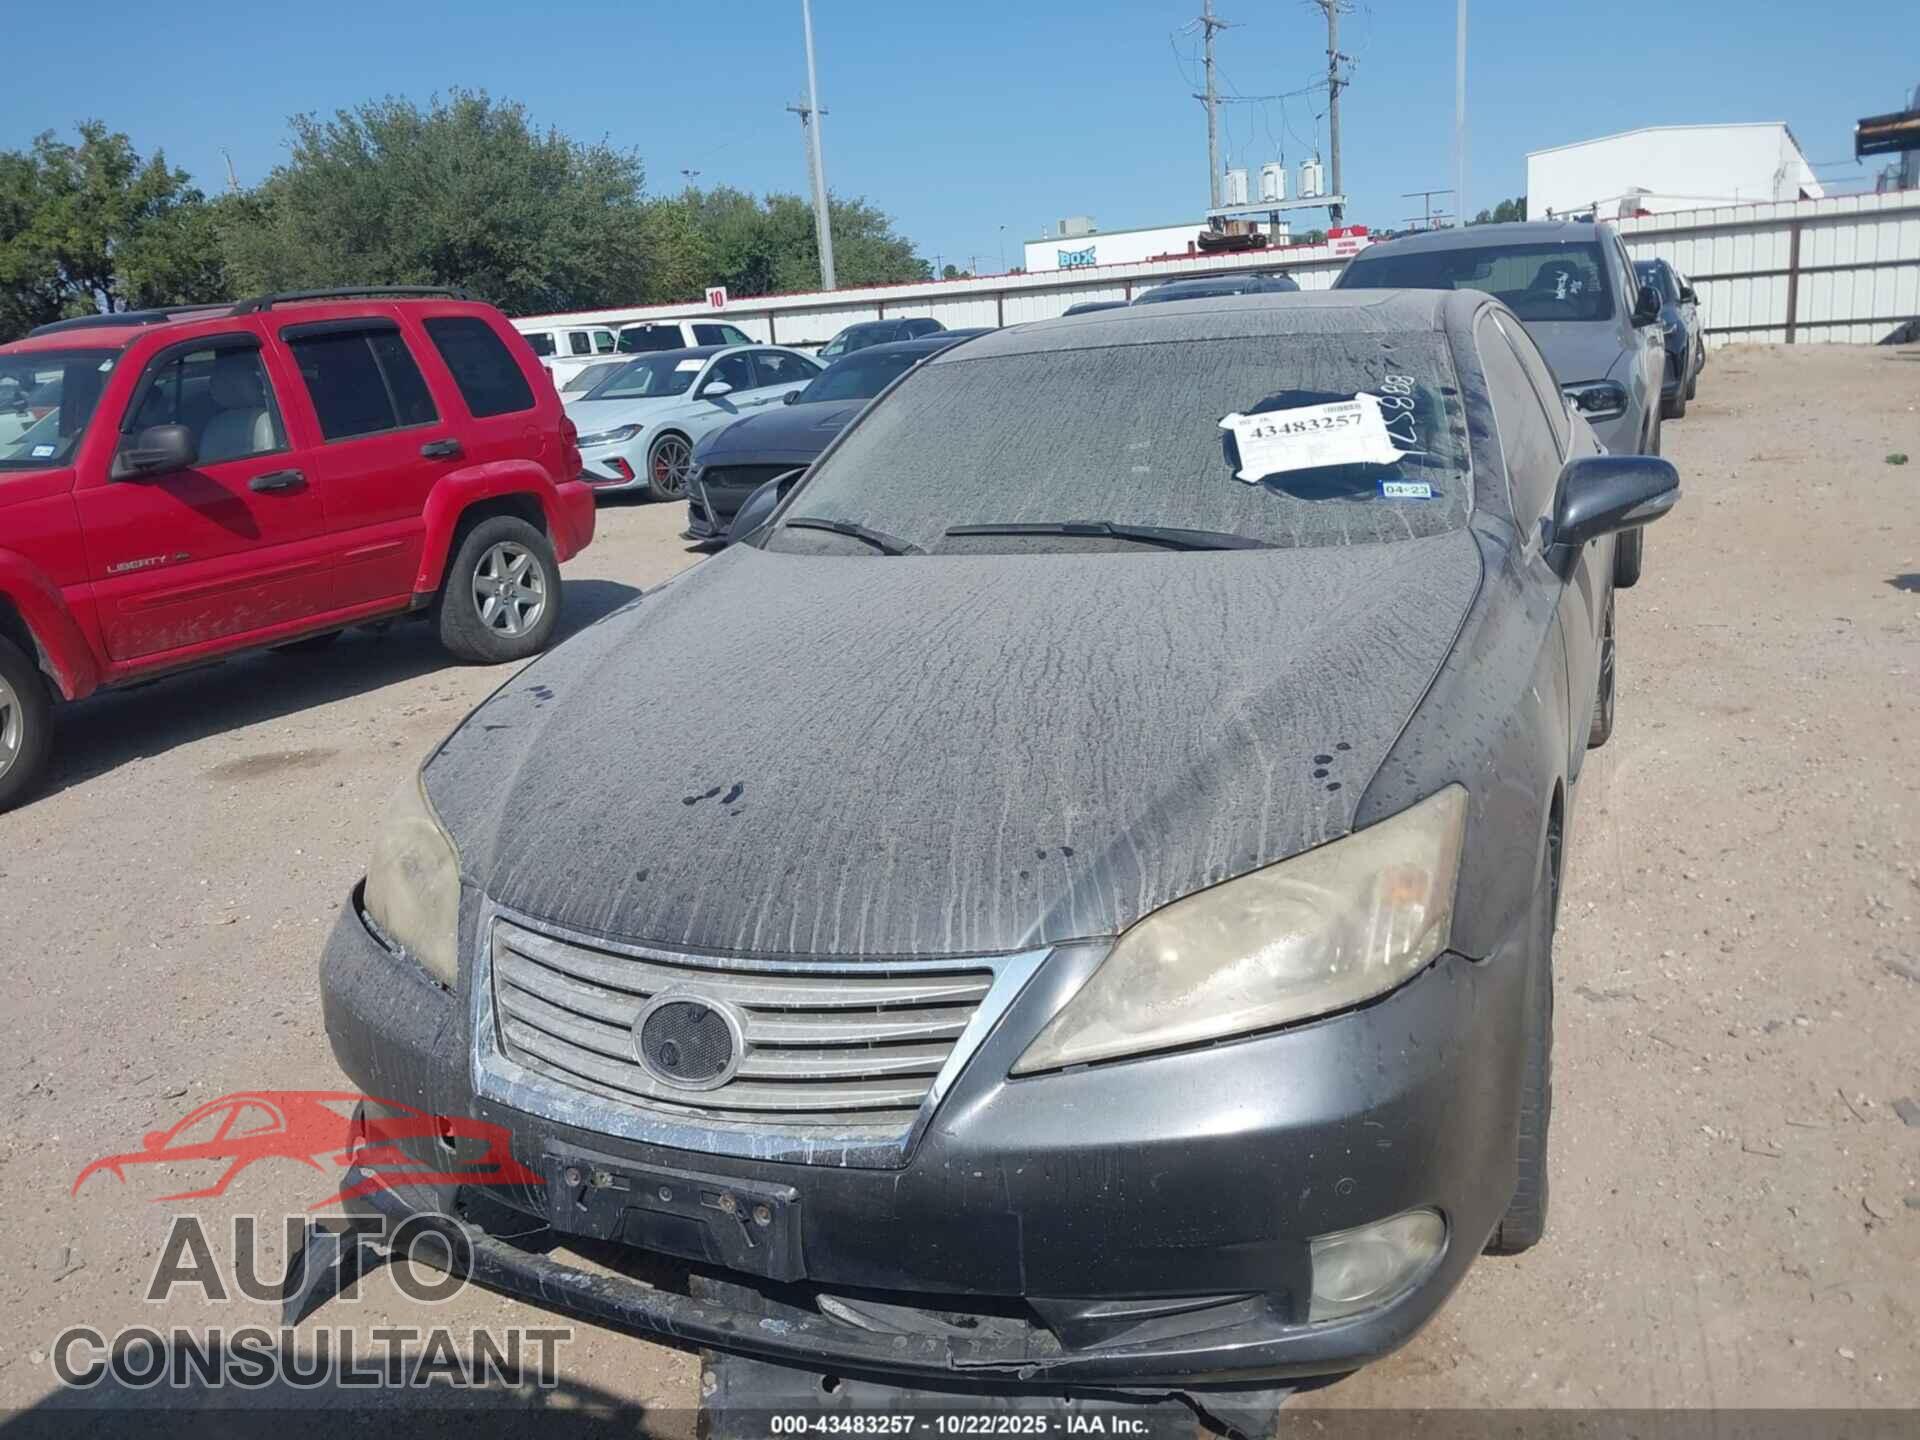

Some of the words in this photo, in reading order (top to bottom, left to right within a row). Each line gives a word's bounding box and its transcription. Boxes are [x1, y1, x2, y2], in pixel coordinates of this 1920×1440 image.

[1058, 246, 1096, 267] BOX
[709, 291, 723, 307] 10
[1250, 413, 1362, 438] 43483257
[106, 555, 166, 573] LIBERTY
